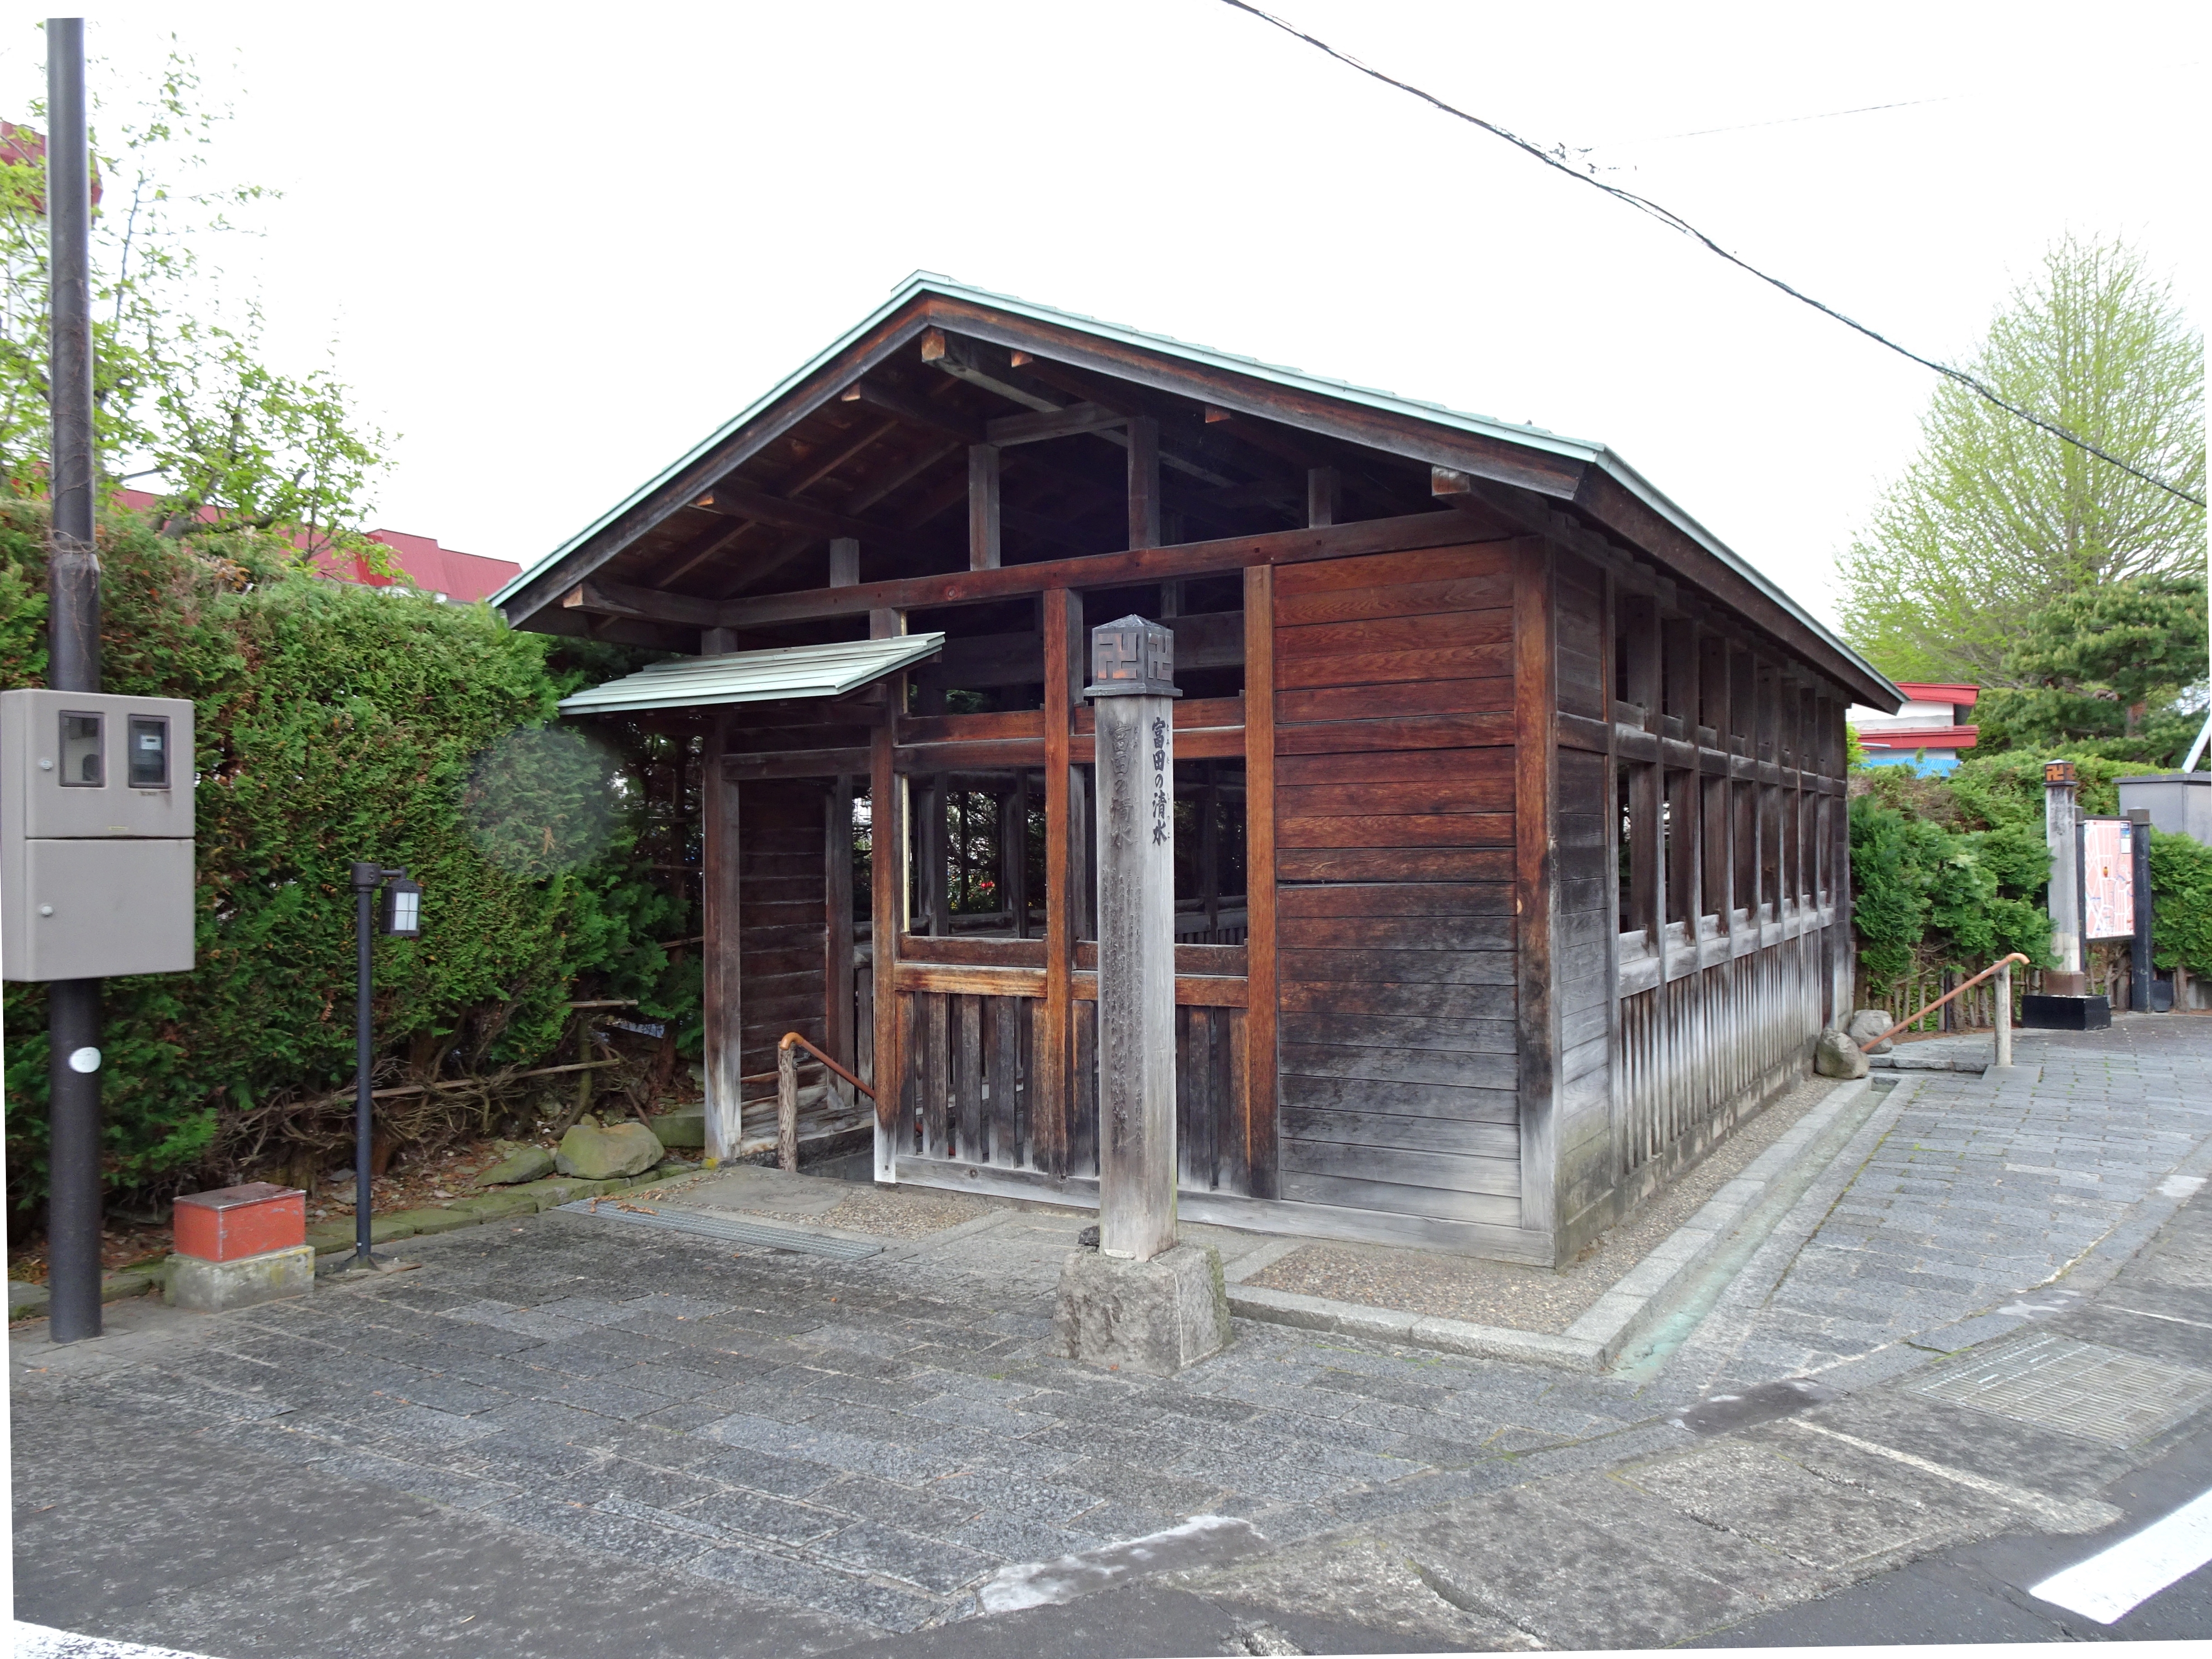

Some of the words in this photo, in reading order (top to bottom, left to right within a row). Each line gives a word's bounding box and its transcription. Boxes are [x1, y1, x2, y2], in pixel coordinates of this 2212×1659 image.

[1109, 720, 1133, 849] 富田の清水
[1152, 717, 1167, 846] 富田の清水
